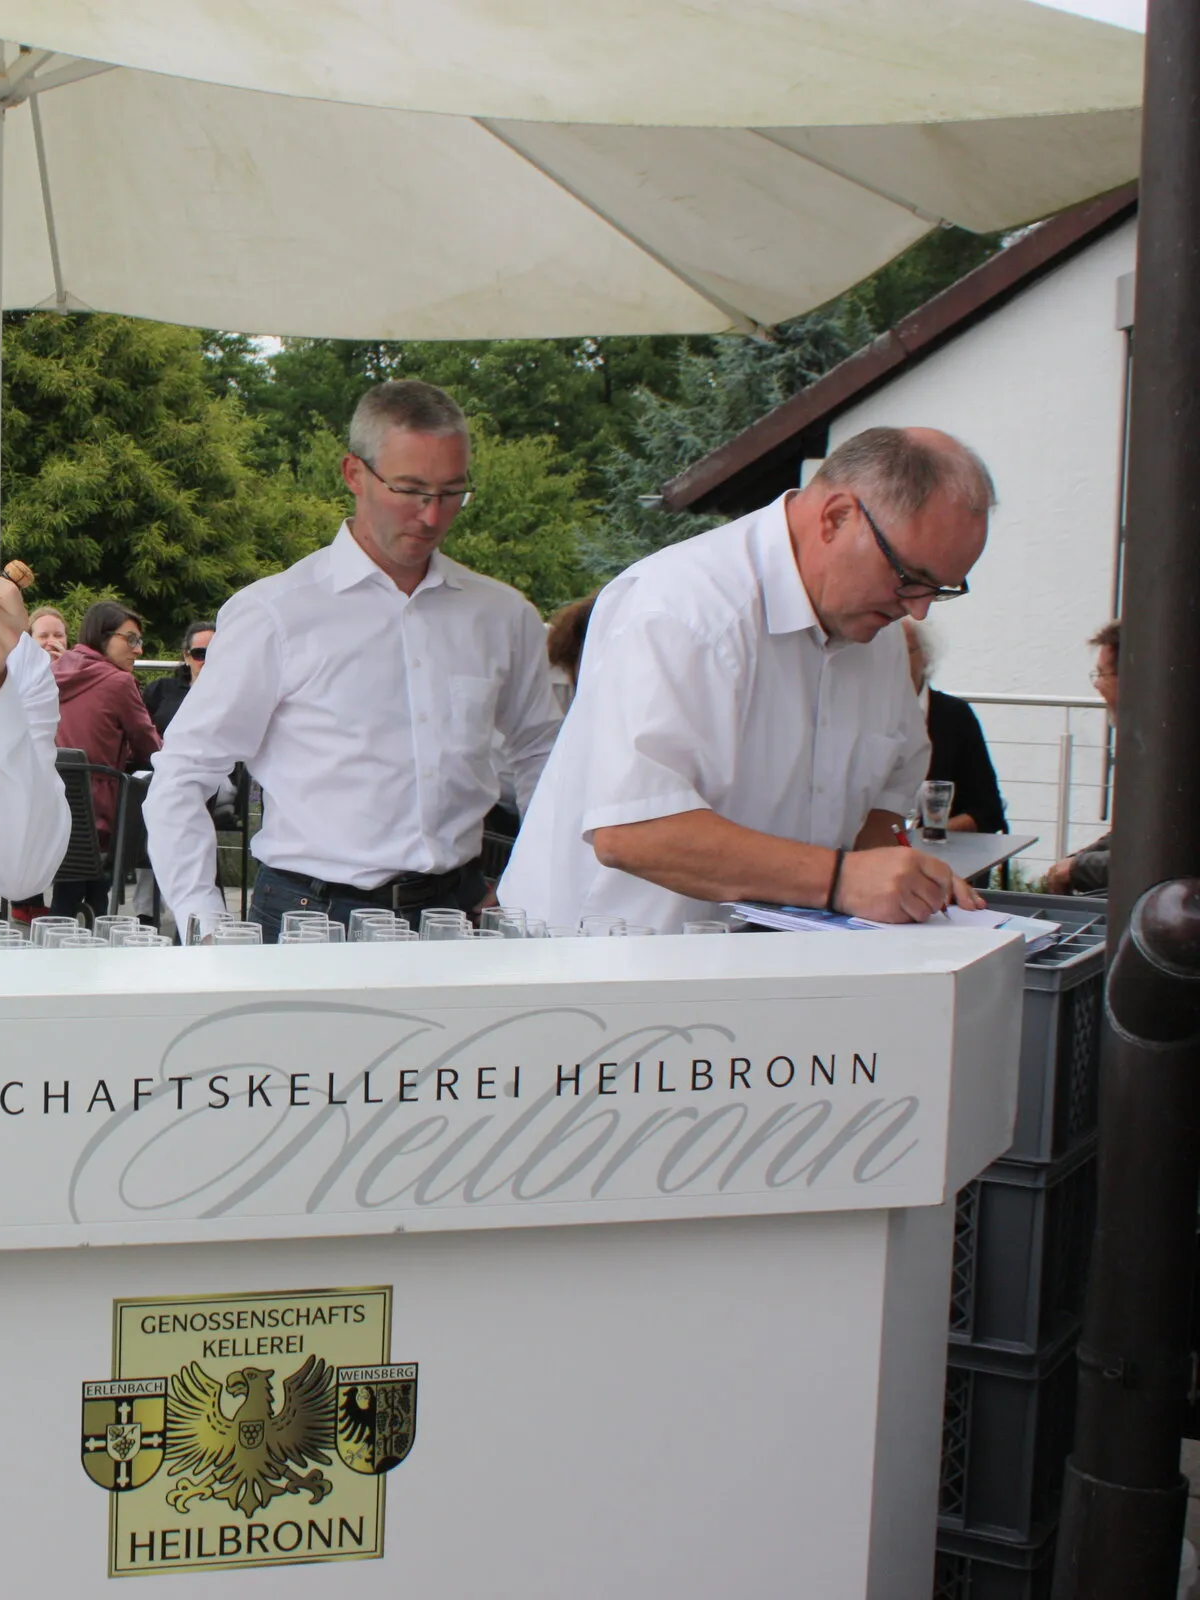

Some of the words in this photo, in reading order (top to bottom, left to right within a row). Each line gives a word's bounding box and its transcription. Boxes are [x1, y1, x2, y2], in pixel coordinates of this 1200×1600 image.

[555, 1052, 880, 1097] HEILBRONN
[68, 1000, 920, 1225] Heilbronn
[140, 1304, 366, 1335] GENOSSENSCHAFTS
[202, 1335, 305, 1359] KELLEREI
[86, 1381, 164, 1397] ERLENBACH
[340, 1367, 415, 1382] WEINSBERG
[128, 1516, 365, 1563] HEILBRONN
